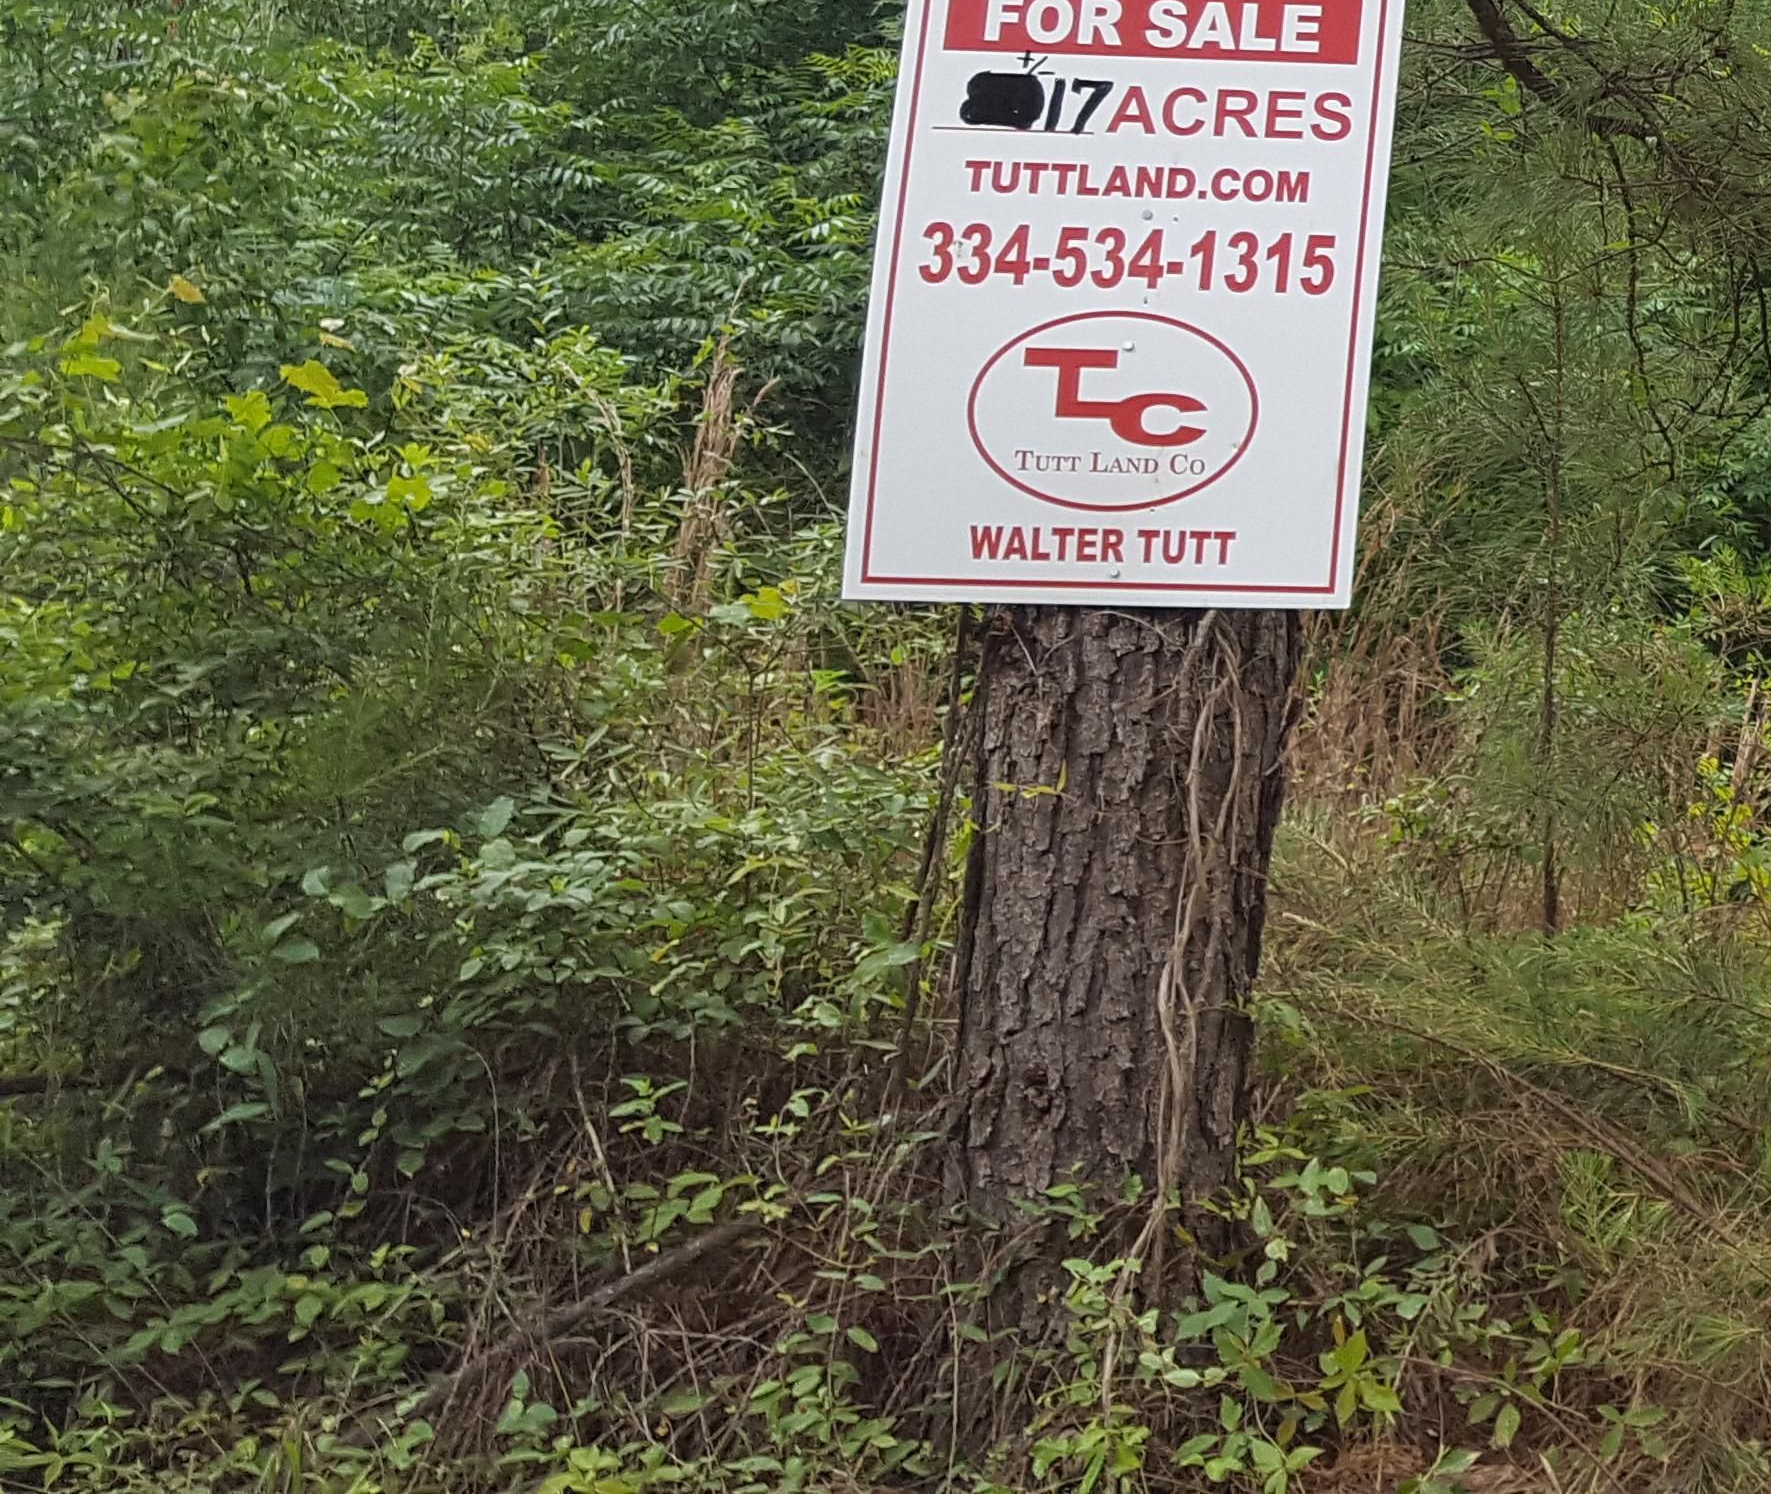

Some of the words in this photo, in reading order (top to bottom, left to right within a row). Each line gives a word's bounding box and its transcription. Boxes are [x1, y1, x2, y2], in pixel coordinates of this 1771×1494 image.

[1106, 85, 1353, 142] ACRES
[964, 159, 1311, 204] TUTTLAND.COM
[918, 221, 1338, 296] 334-534-1315
[969, 524, 1125, 564] WALTER
[1137, 529, 1238, 566] TUTT
